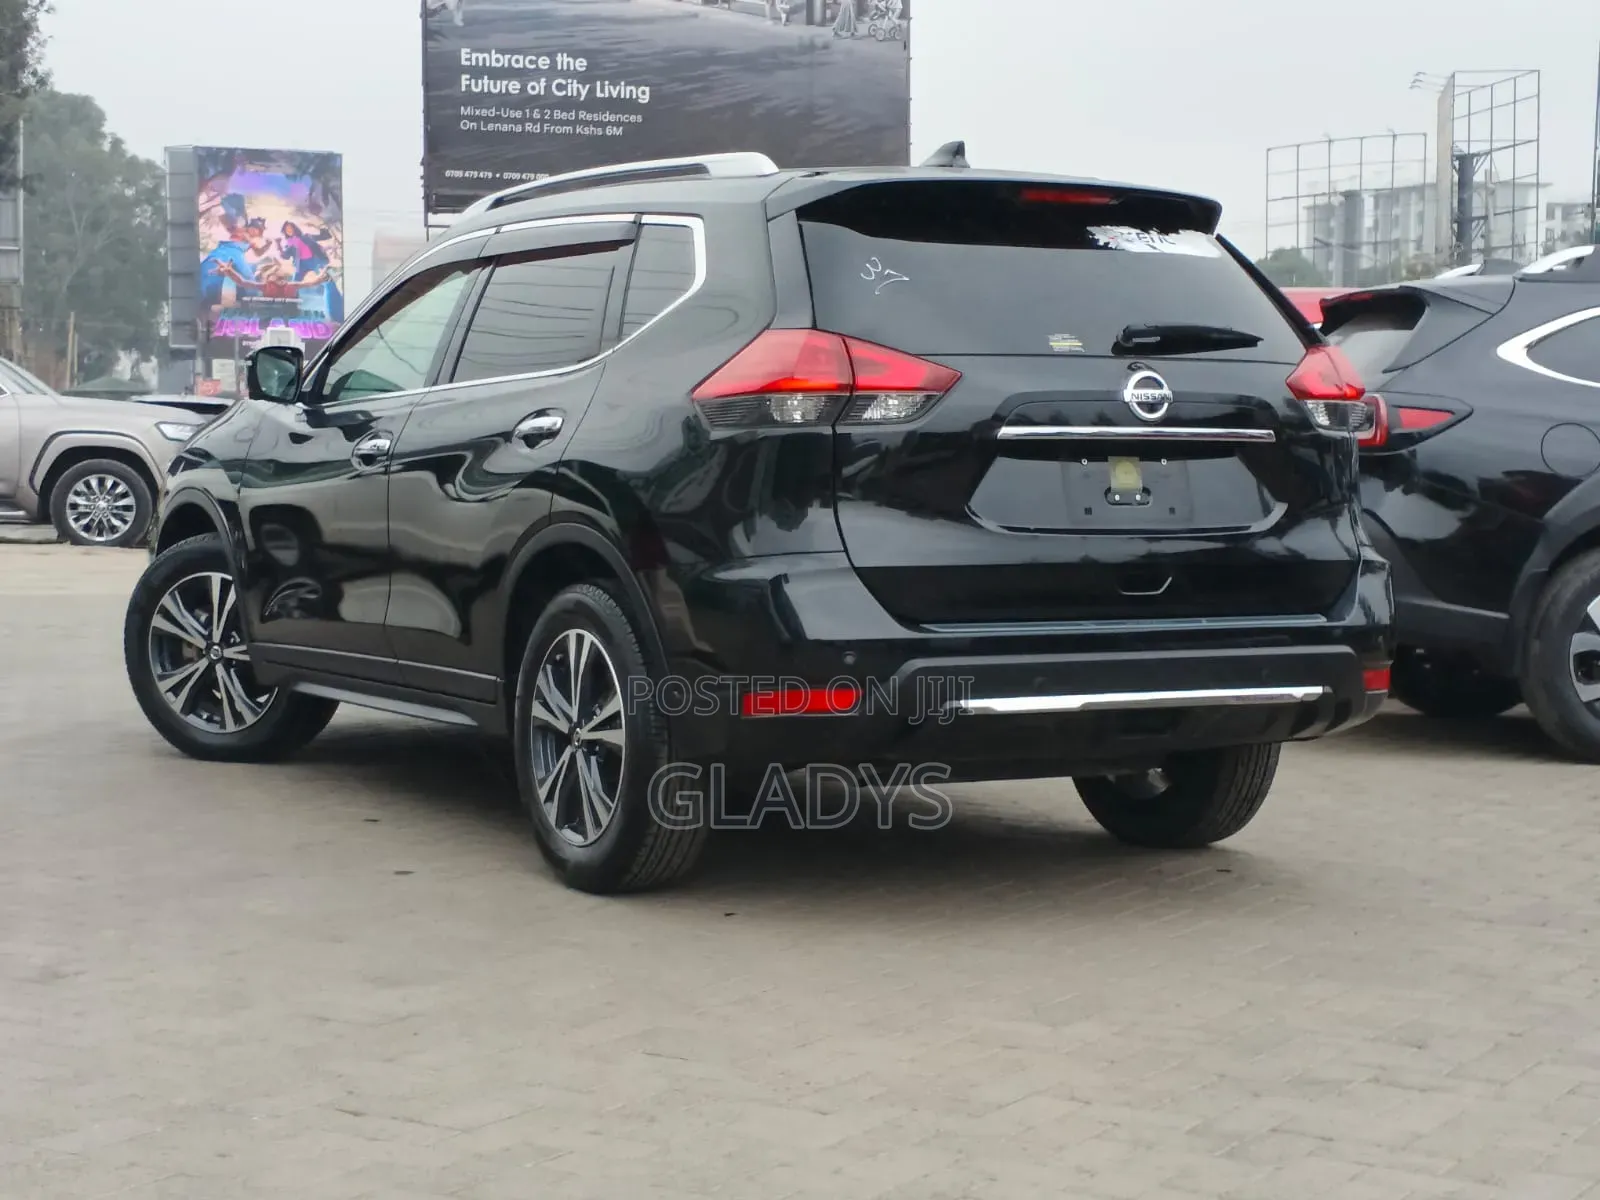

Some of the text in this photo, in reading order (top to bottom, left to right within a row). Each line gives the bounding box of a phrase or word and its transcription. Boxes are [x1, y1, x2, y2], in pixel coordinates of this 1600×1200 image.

[461, 48, 588, 71] Embrace the
[461, 74, 650, 104] Future of City Living
[460, 106, 643, 123] Mixed-Use 1 & 2 Bed Residences
[460, 120, 624, 136] On Lenana Rd From Kshs 6M
[1131, 392, 1172, 402] NISSAN
